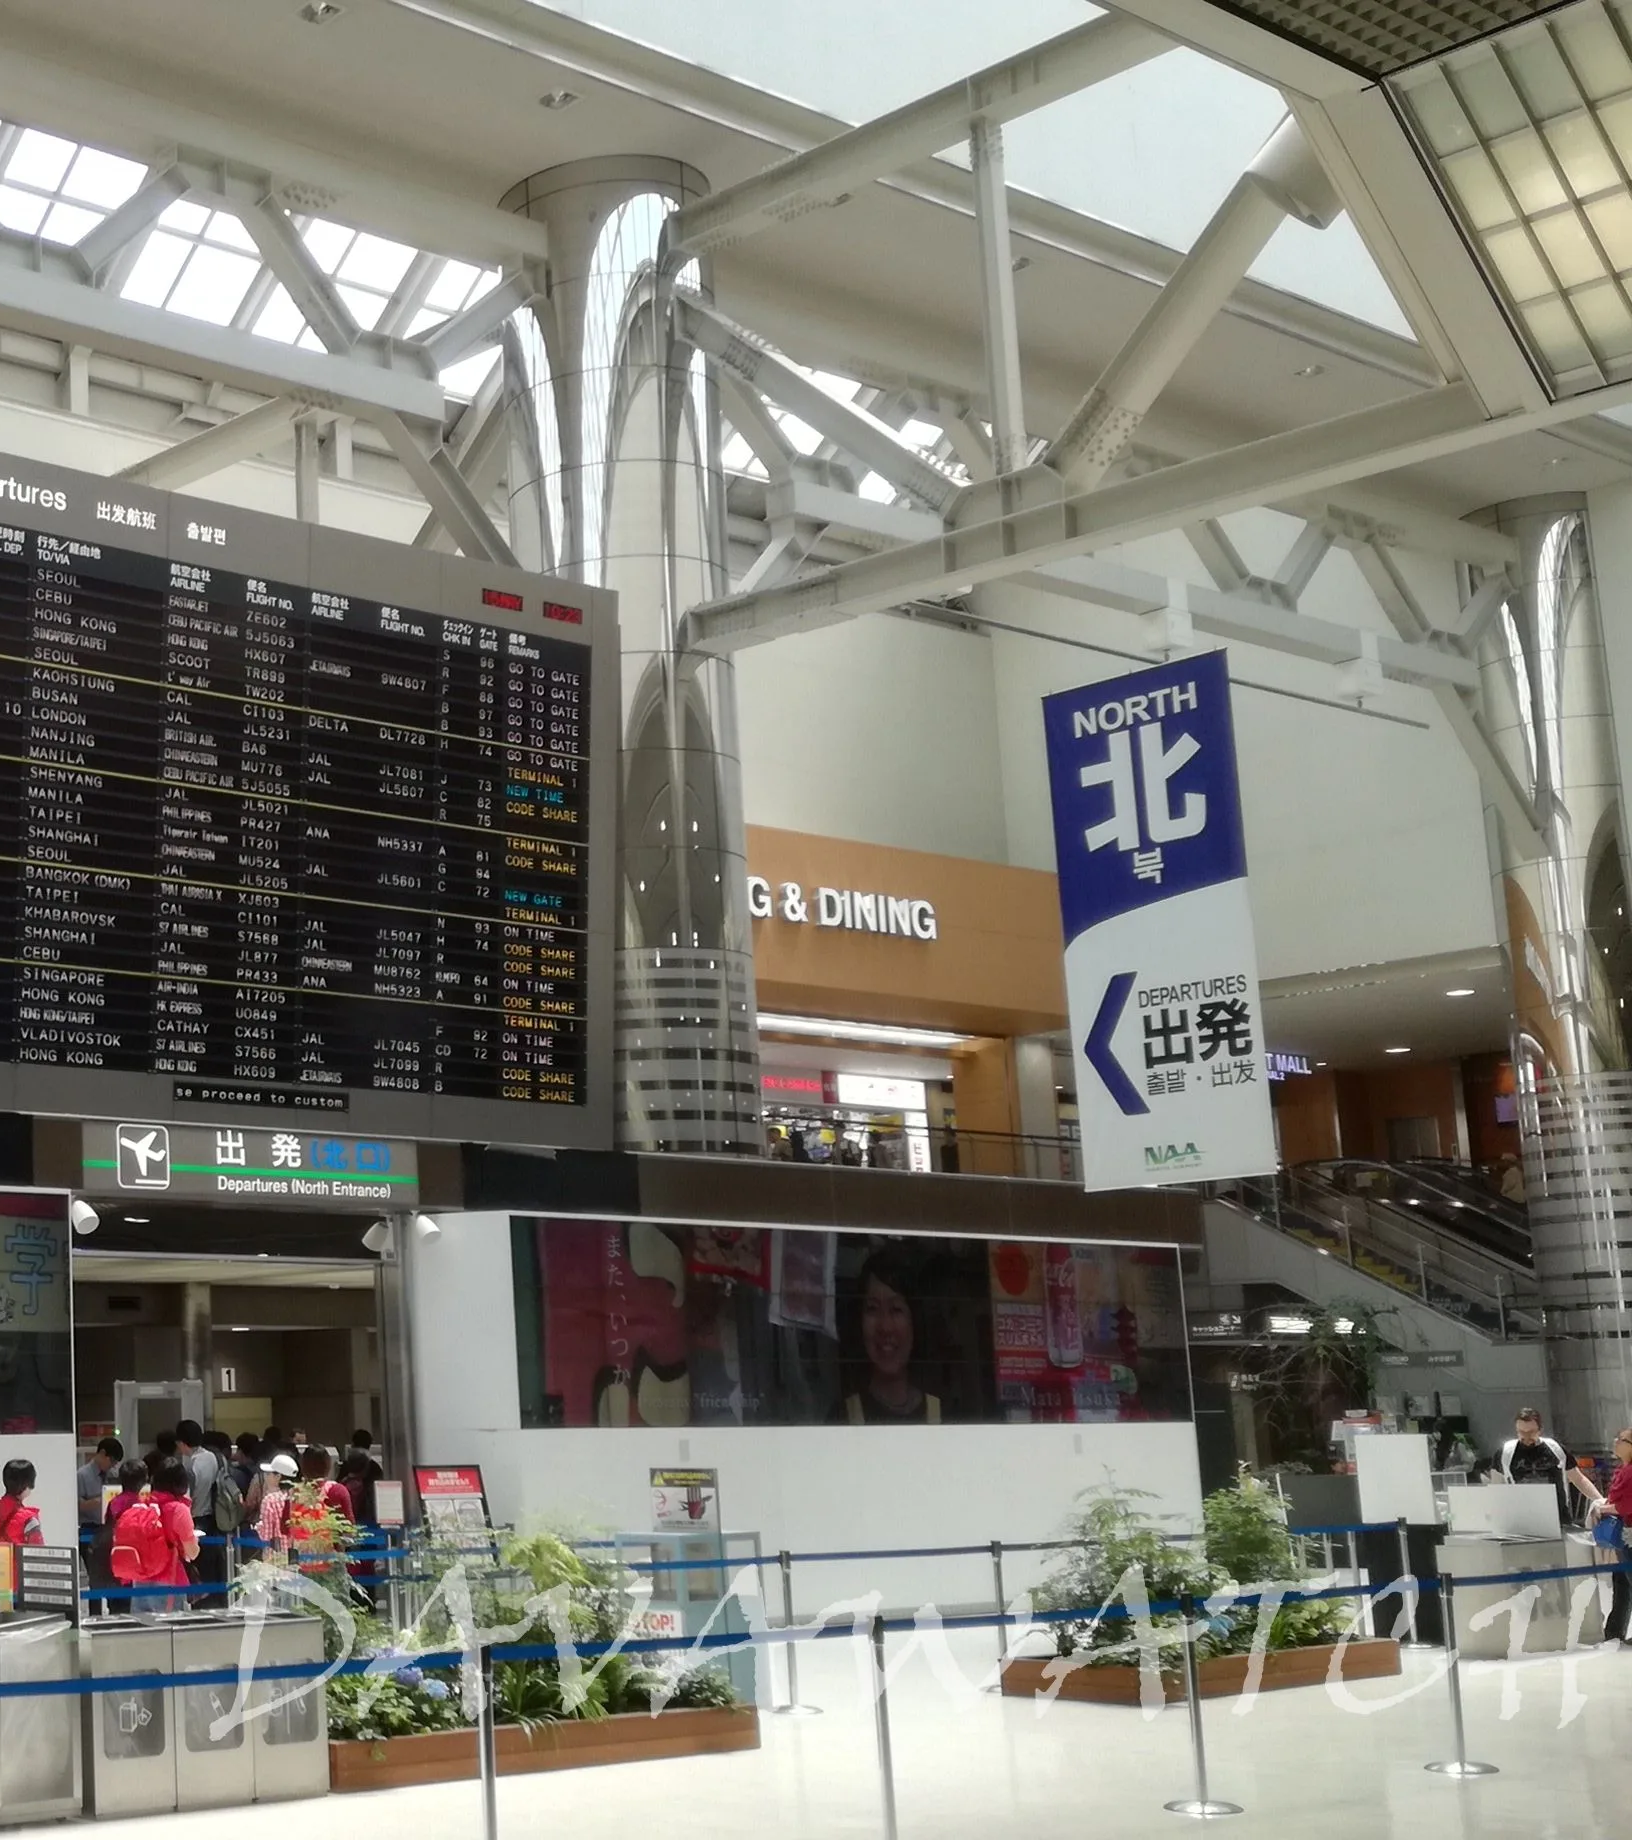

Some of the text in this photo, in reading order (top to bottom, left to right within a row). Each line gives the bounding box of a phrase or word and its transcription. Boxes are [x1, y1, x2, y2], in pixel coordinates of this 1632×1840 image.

[96, 502, 156, 531] 出发航班
[187, 522, 226, 547] 출발편
[37, 549, 70, 566] TO/VIA
[37, 566, 81, 588] SEOUL
[170, 576, 205, 593] AIRLINE
[171, 564, 211, 583] 航空会社
[36, 588, 72, 606] CEBU
[35, 608, 117, 634] HONG KONG
[480, 640, 498, 651] GATE
[509, 662, 579, 686] GO TO GATE
[31, 704, 87, 726] LONDON
[1073, 681, 1197, 738] NORTH
[309, 713, 349, 733] DELTA
[30, 725, 95, 748] NANJING
[507, 766, 564, 787] TERMINAL
[506, 783, 564, 804] NEW TIME
[1080, 723, 1207, 853] 北
[505, 800, 577, 824] CODE SHARE
[28, 826, 100, 848] SHANGHAI
[1133, 847, 1164, 883] 북
[24, 907, 116, 929] KHABAROVSK
[783, 882, 808, 922] &
[819, 887, 937, 940] DINING
[23, 968, 105, 988] SINGAPORE
[1138, 975, 1248, 1008] DEPARTURES
[21, 1027, 122, 1048] VLADIVOSTOK
[157, 1020, 210, 1036] CATHAY
[1143, 998, 1253, 1069] 出発
[1211, 1060, 1257, 1088] 出发
[1276, 1054, 1312, 1074] MALL
[1147, 1070, 1187, 1096] 출발
[176, 1087, 344, 1108] se proceed to custom
[218, 1176, 391, 1199] Departures (North Entrance)
